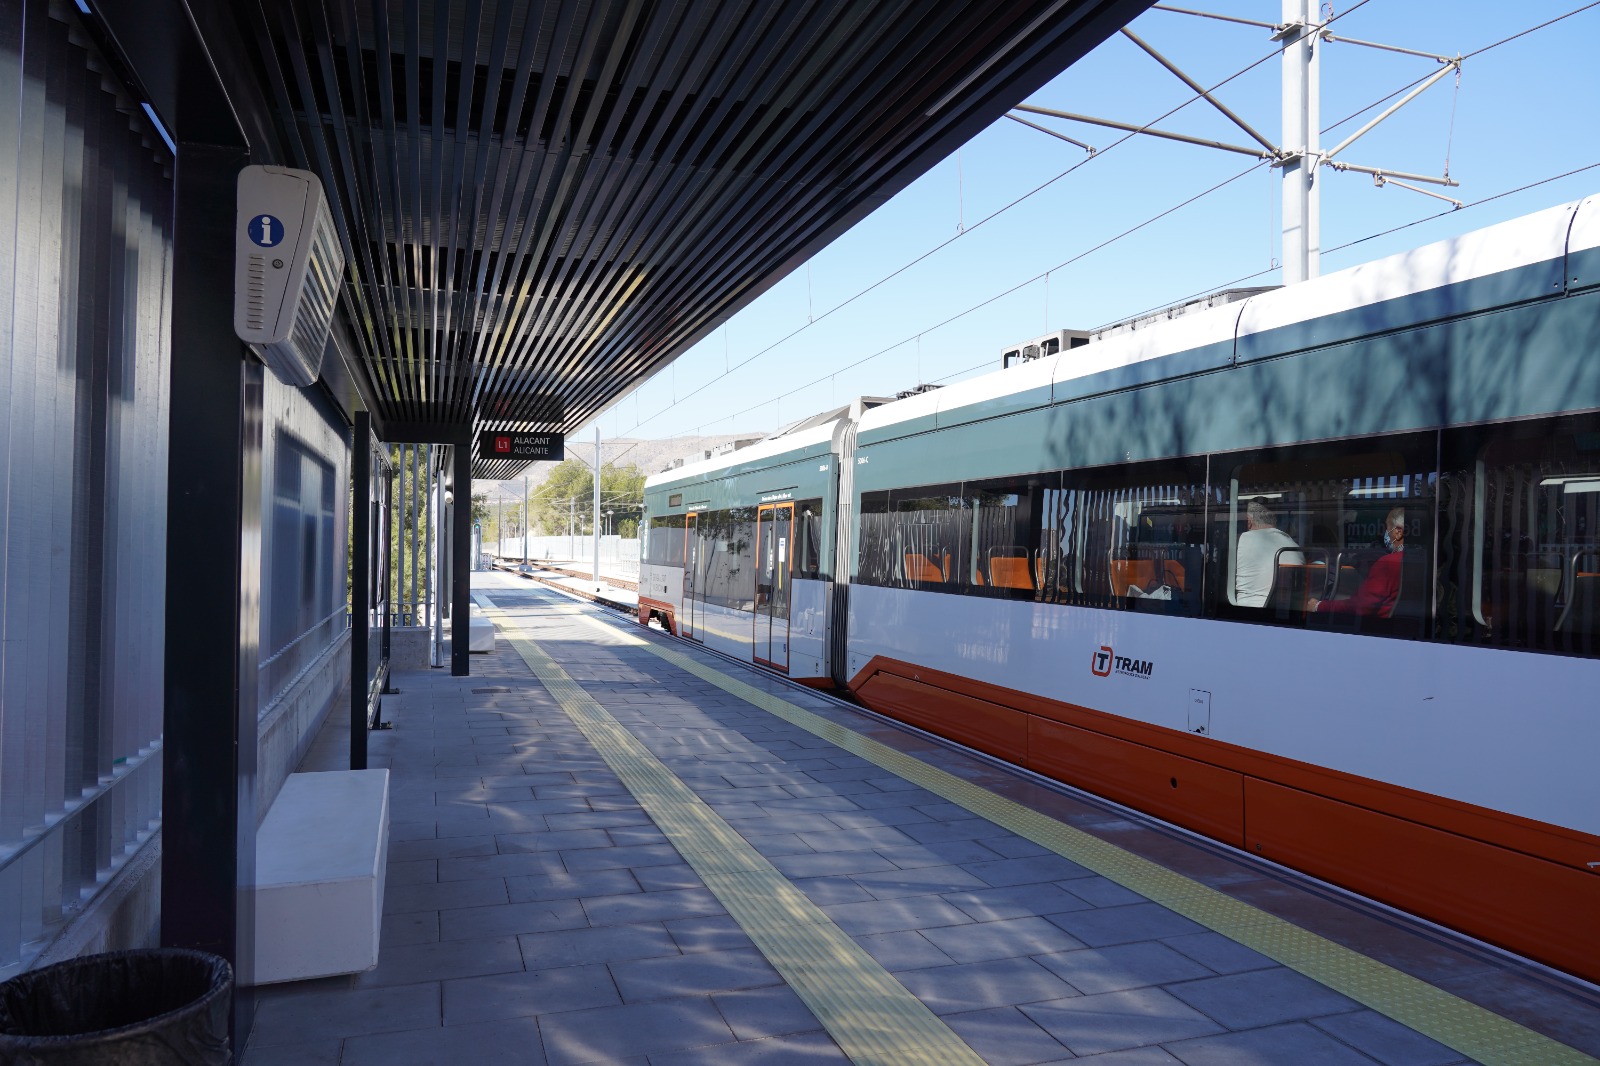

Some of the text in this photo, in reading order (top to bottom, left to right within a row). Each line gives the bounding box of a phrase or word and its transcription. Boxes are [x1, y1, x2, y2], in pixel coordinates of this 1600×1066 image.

[261, 216, 272, 244] i
[498, 441, 508, 449] L1
[513, 436, 550, 445] ALACANT
[513, 446, 549, 455] ALICANTE
[1115, 655, 1153, 676] TRAM
